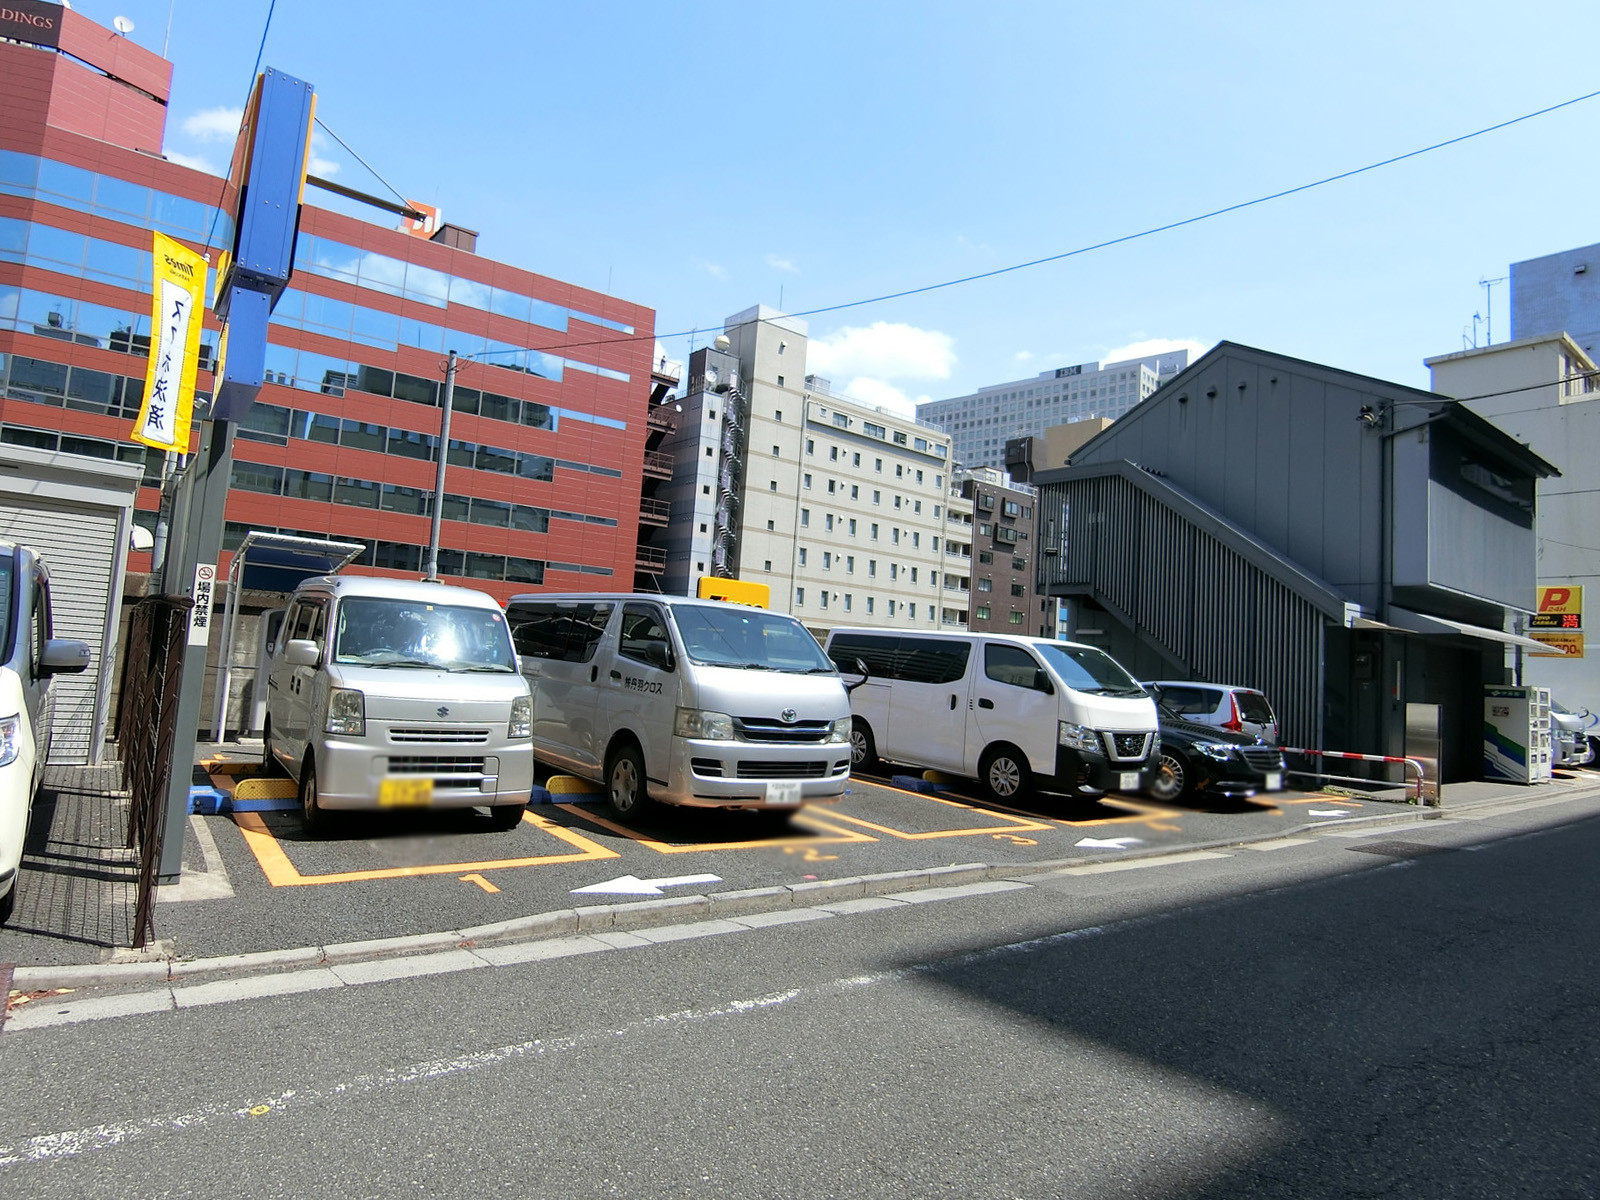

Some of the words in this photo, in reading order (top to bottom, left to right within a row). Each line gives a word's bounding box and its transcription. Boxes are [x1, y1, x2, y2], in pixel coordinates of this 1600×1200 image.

[1, 8, 54, 29] DINGS
[193, 582, 211, 628] 場内禁煙
[1539, 588, 1571, 612] P
[1562, 614, 1579, 628] 満
